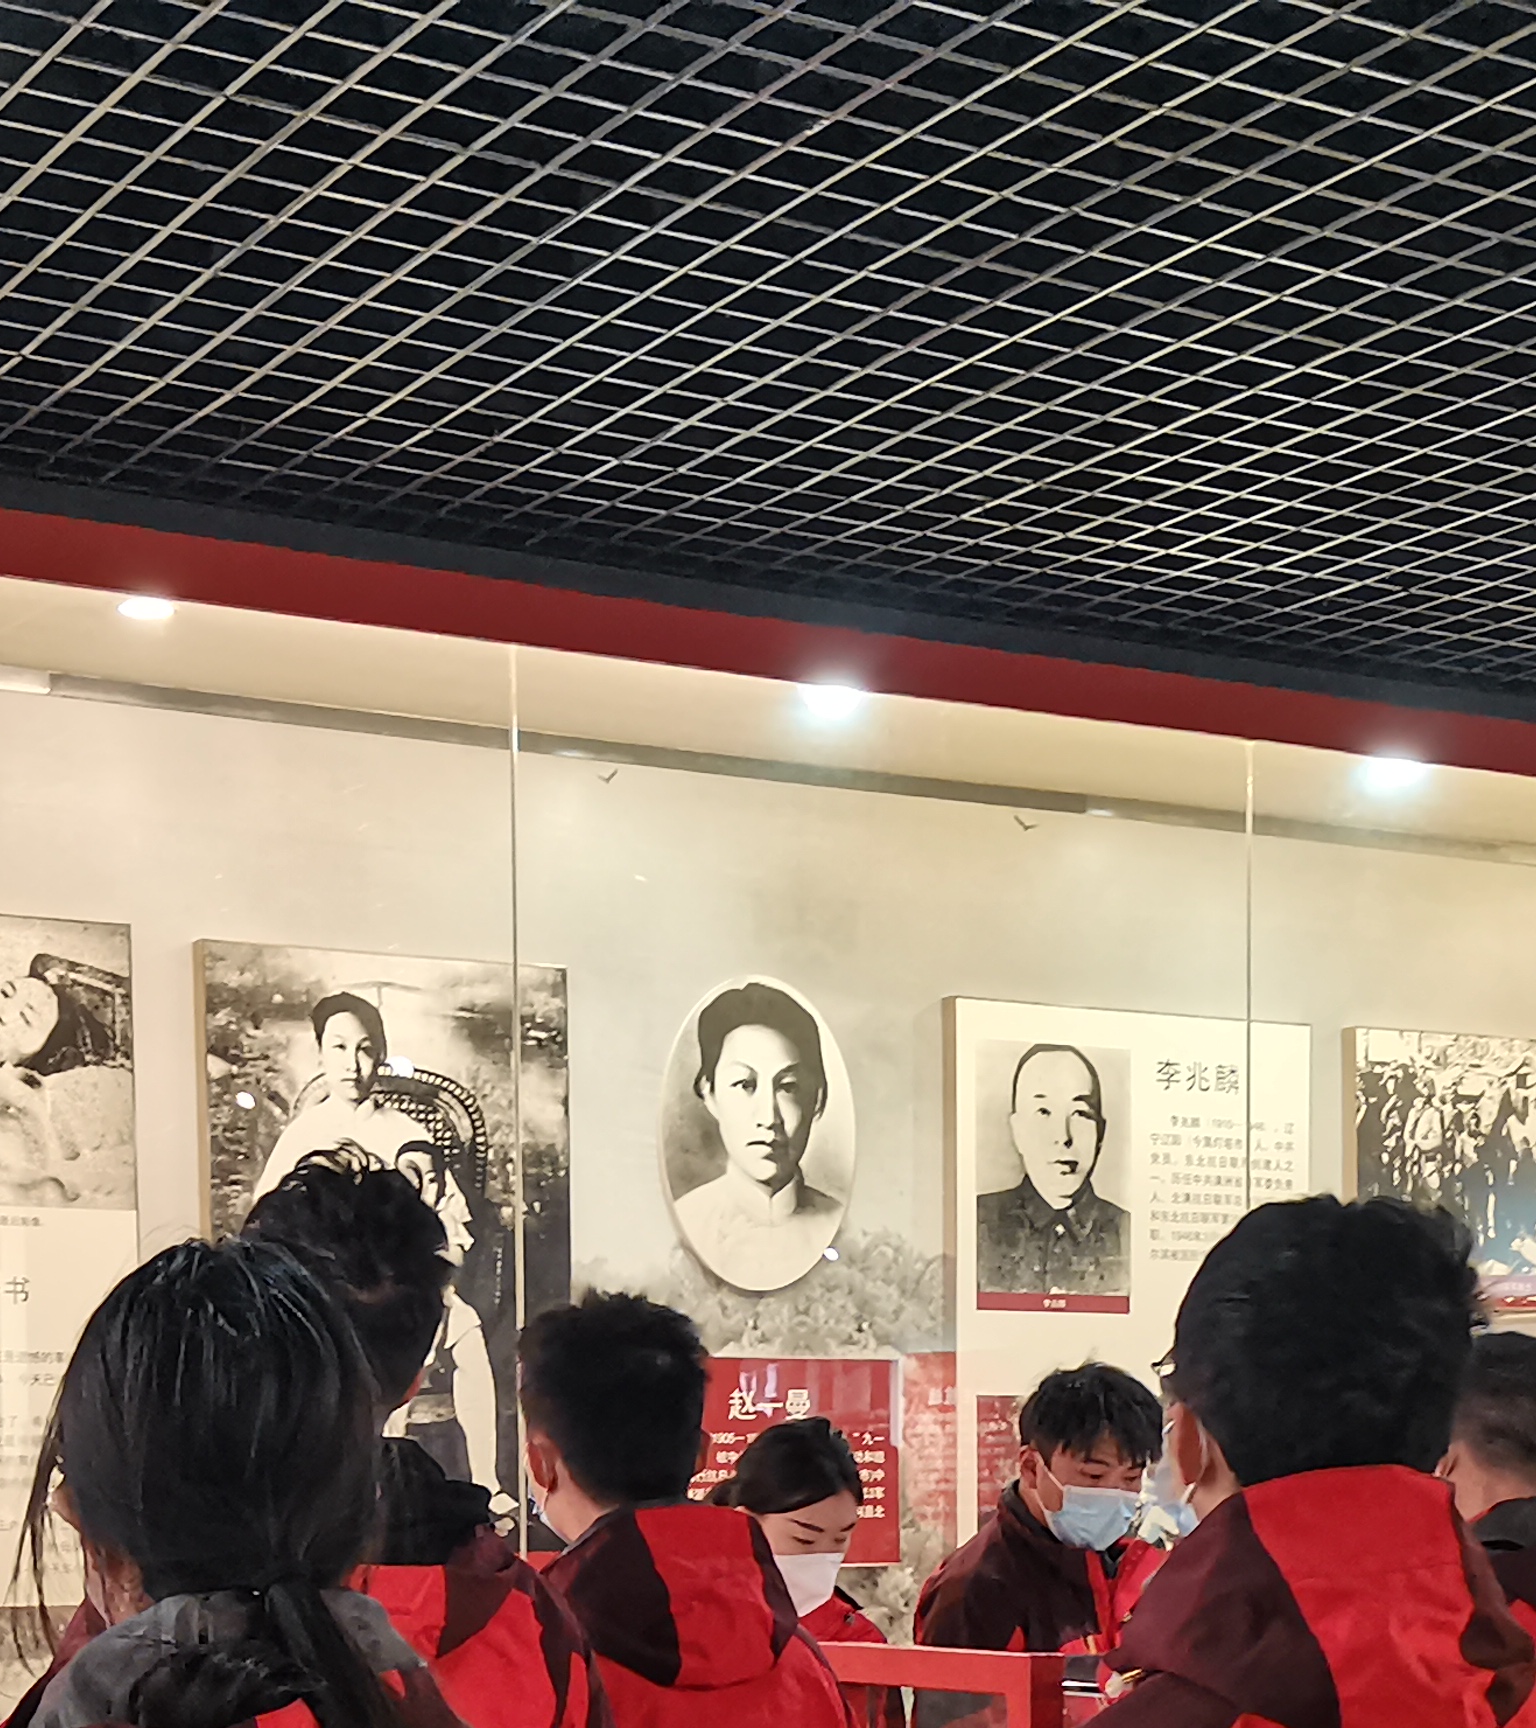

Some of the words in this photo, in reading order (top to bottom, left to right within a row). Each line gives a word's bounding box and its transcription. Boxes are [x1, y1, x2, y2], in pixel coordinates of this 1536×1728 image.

[1155, 1058, 1240, 1096] 李兆麟
[727, 1386, 811, 1421] 赵一曼
